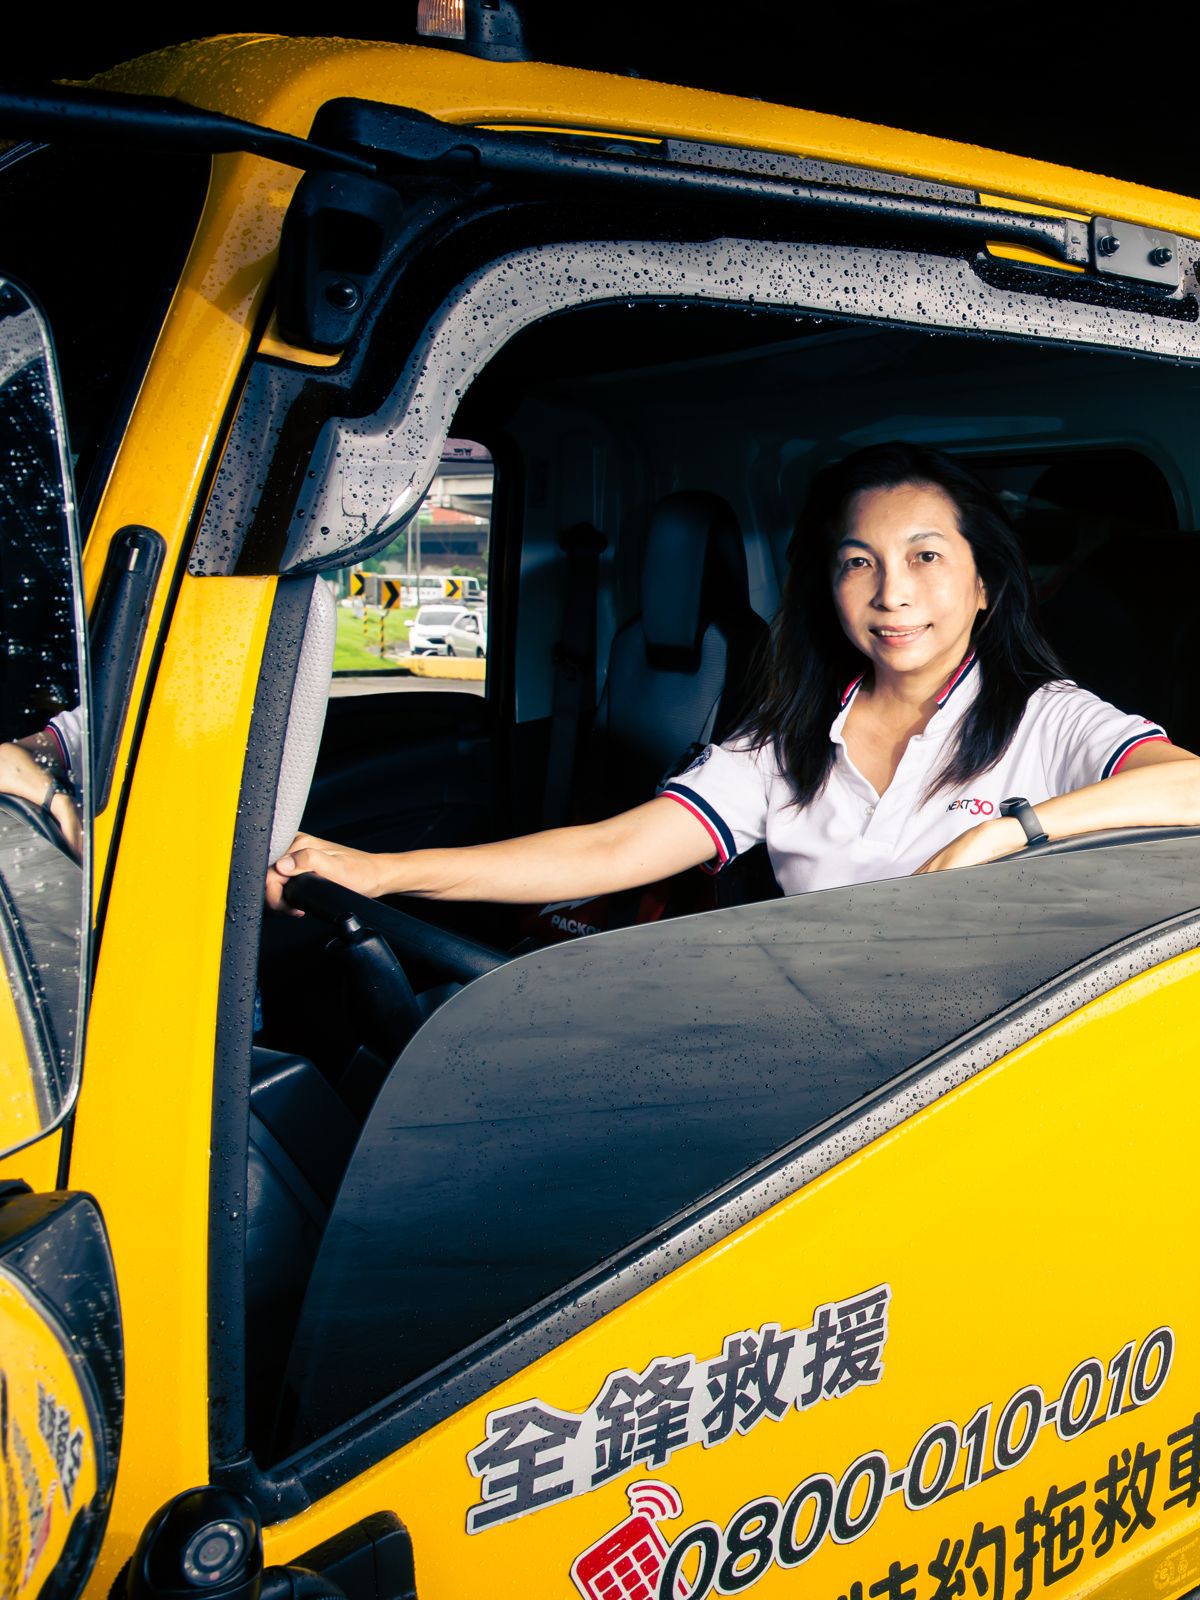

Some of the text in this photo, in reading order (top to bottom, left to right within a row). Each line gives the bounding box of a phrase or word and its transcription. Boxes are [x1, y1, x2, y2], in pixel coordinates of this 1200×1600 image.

[466, 1283, 892, 1535] 全鋒救援
[657, 1326, 1176, 1600] 0800-010-010
